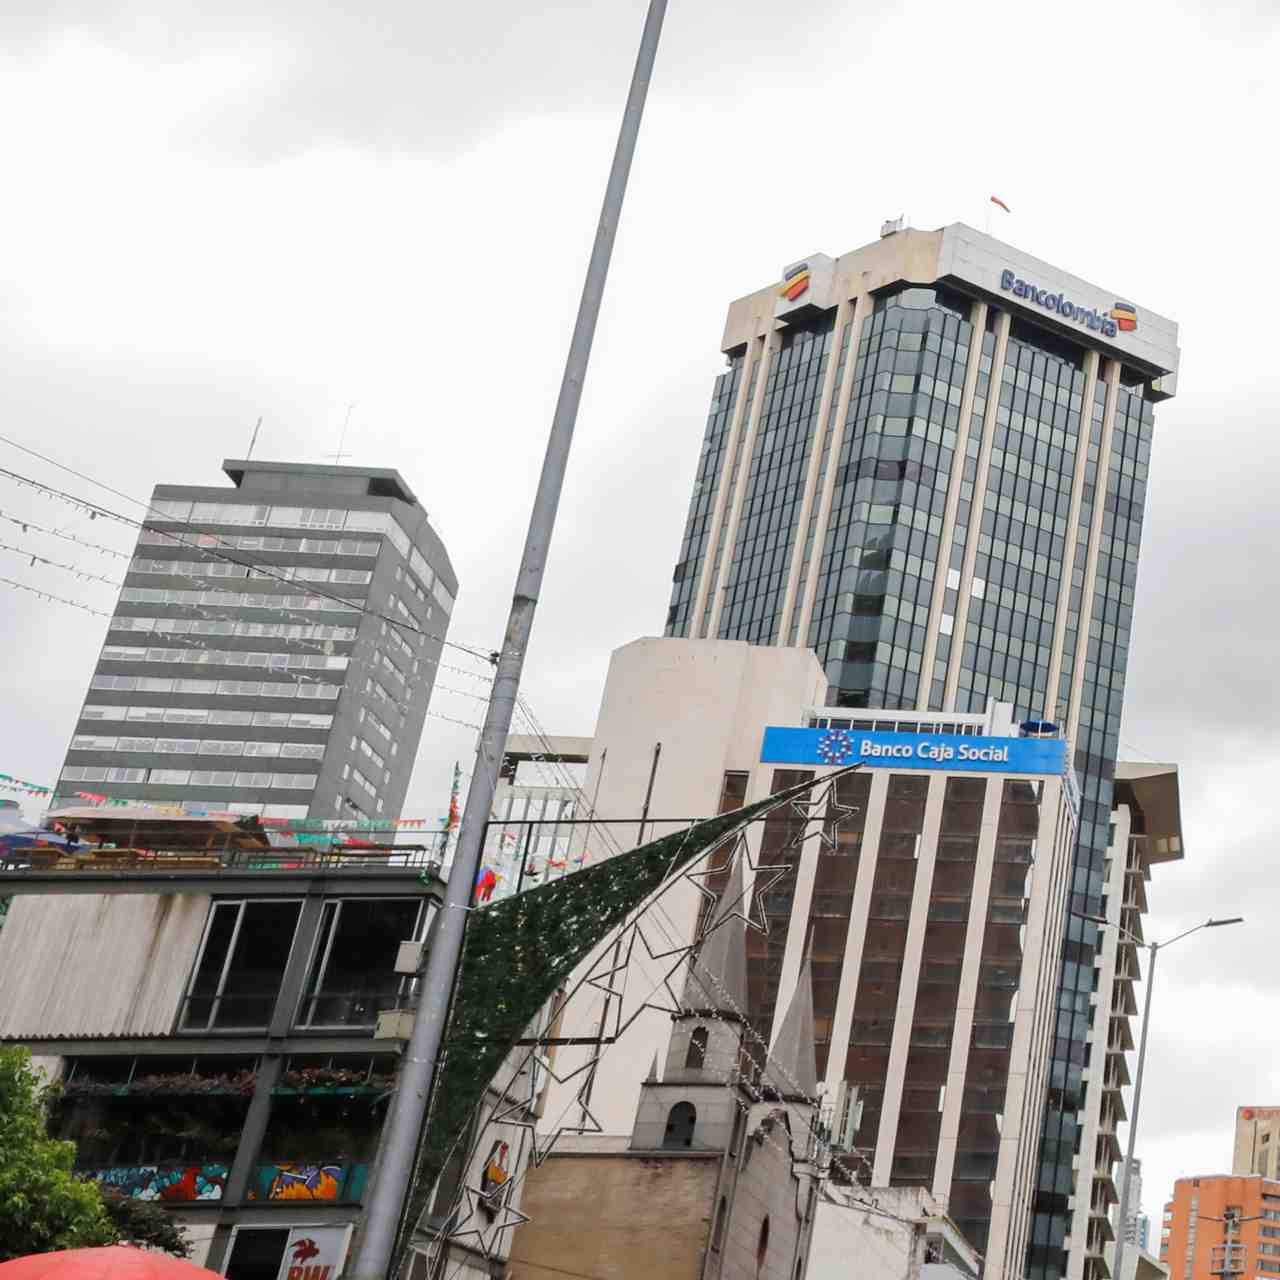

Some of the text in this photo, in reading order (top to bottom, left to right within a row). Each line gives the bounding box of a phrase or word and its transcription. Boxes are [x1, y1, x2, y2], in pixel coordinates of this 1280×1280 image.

[1001, 269, 1117, 338] Bancolombia
[860, 740, 1009, 762] Banco Caja Social
